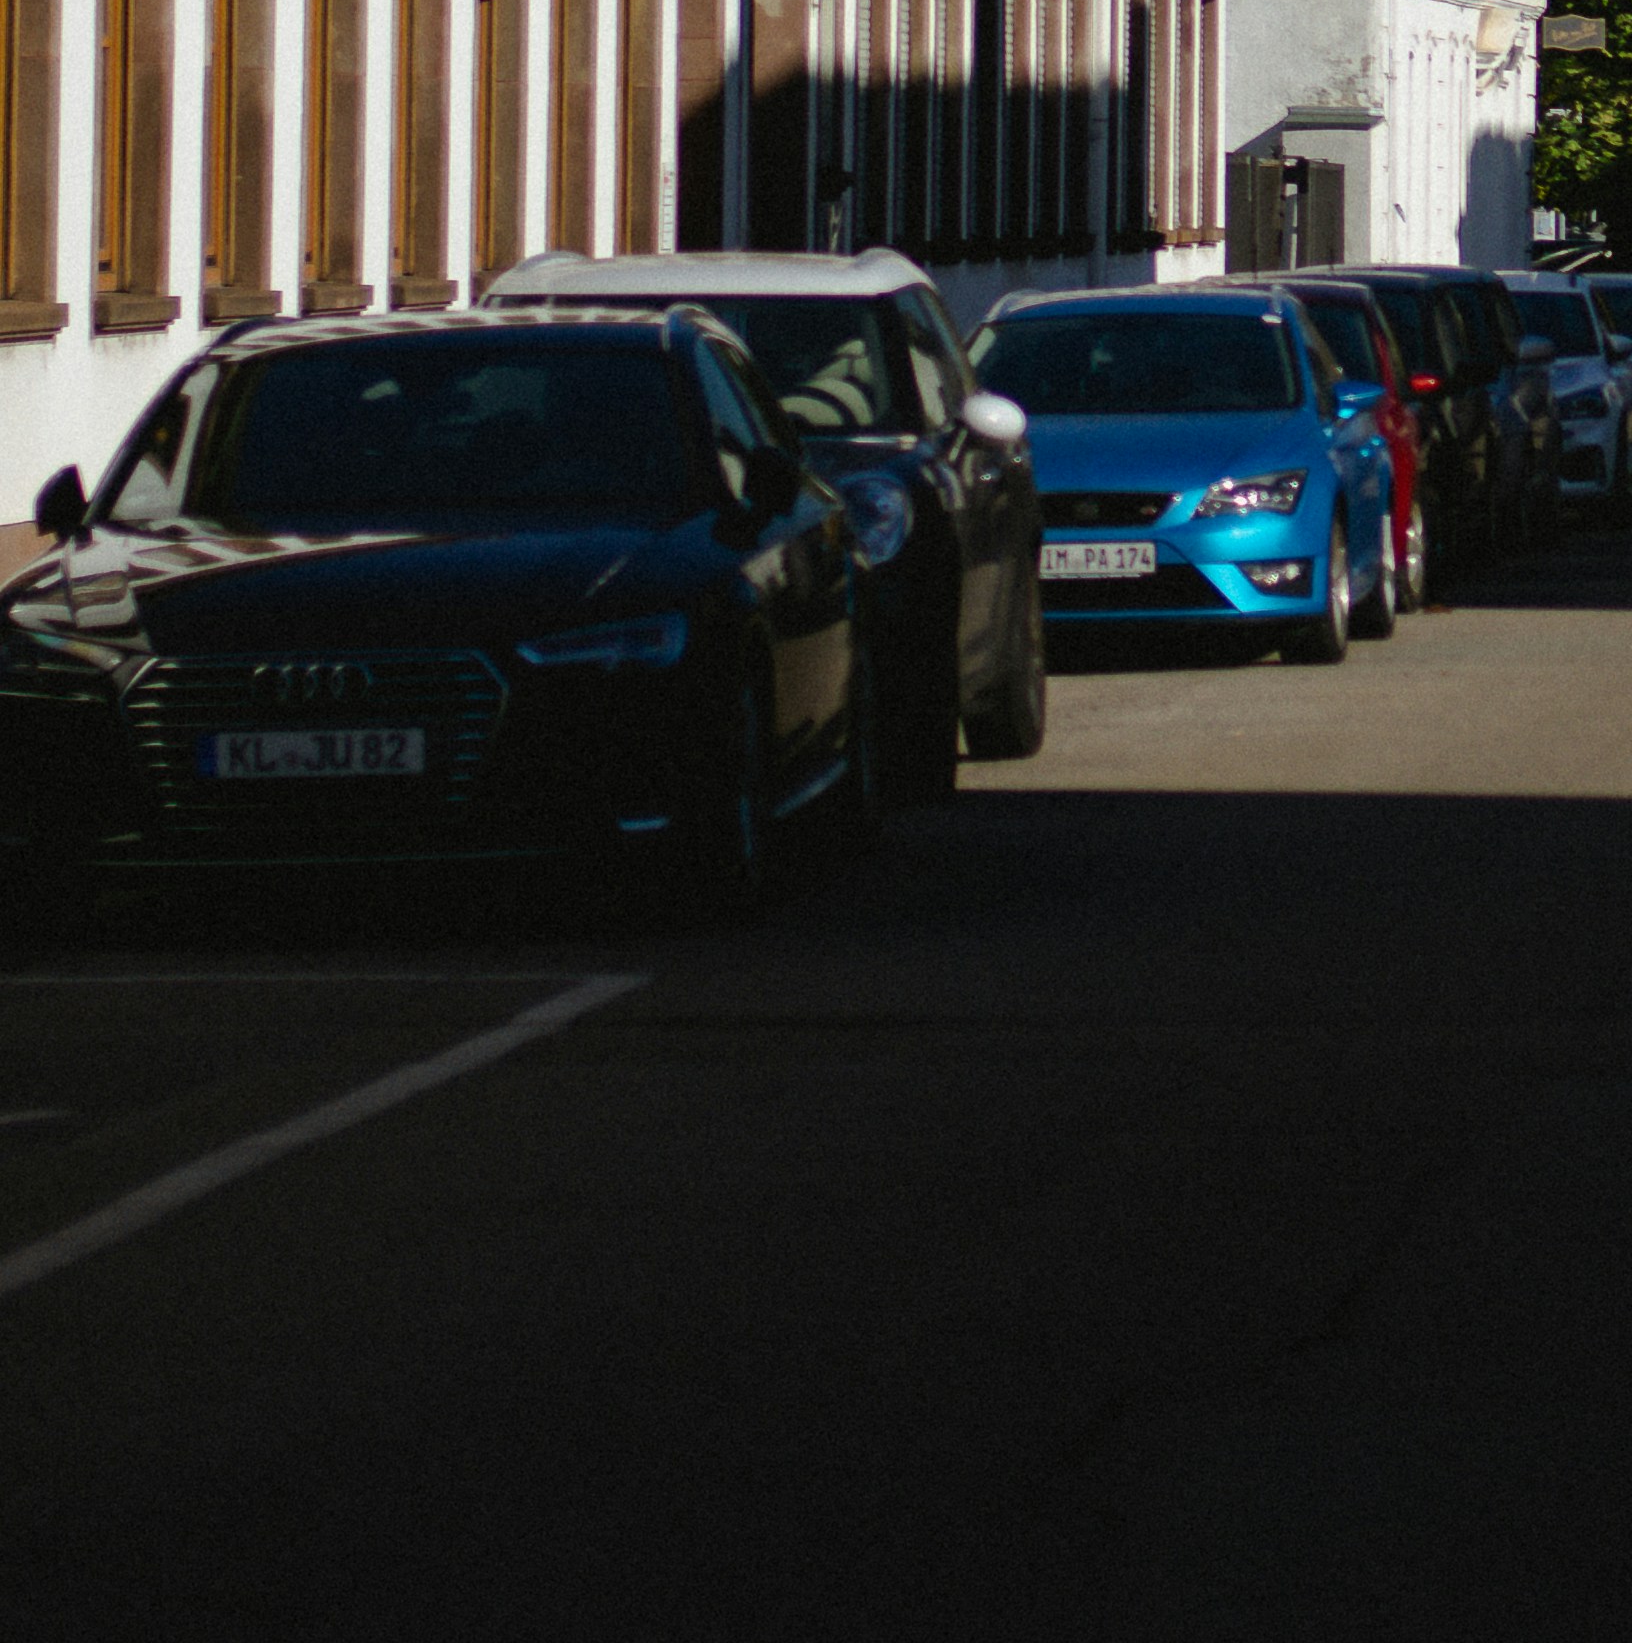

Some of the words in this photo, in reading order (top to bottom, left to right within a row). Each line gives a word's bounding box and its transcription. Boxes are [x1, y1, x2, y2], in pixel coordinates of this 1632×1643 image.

[1115, 547, 1151, 568] 174
[229, 737, 276, 771] KL
[304, 734, 352, 770] JU
[362, 733, 407, 769] 82
